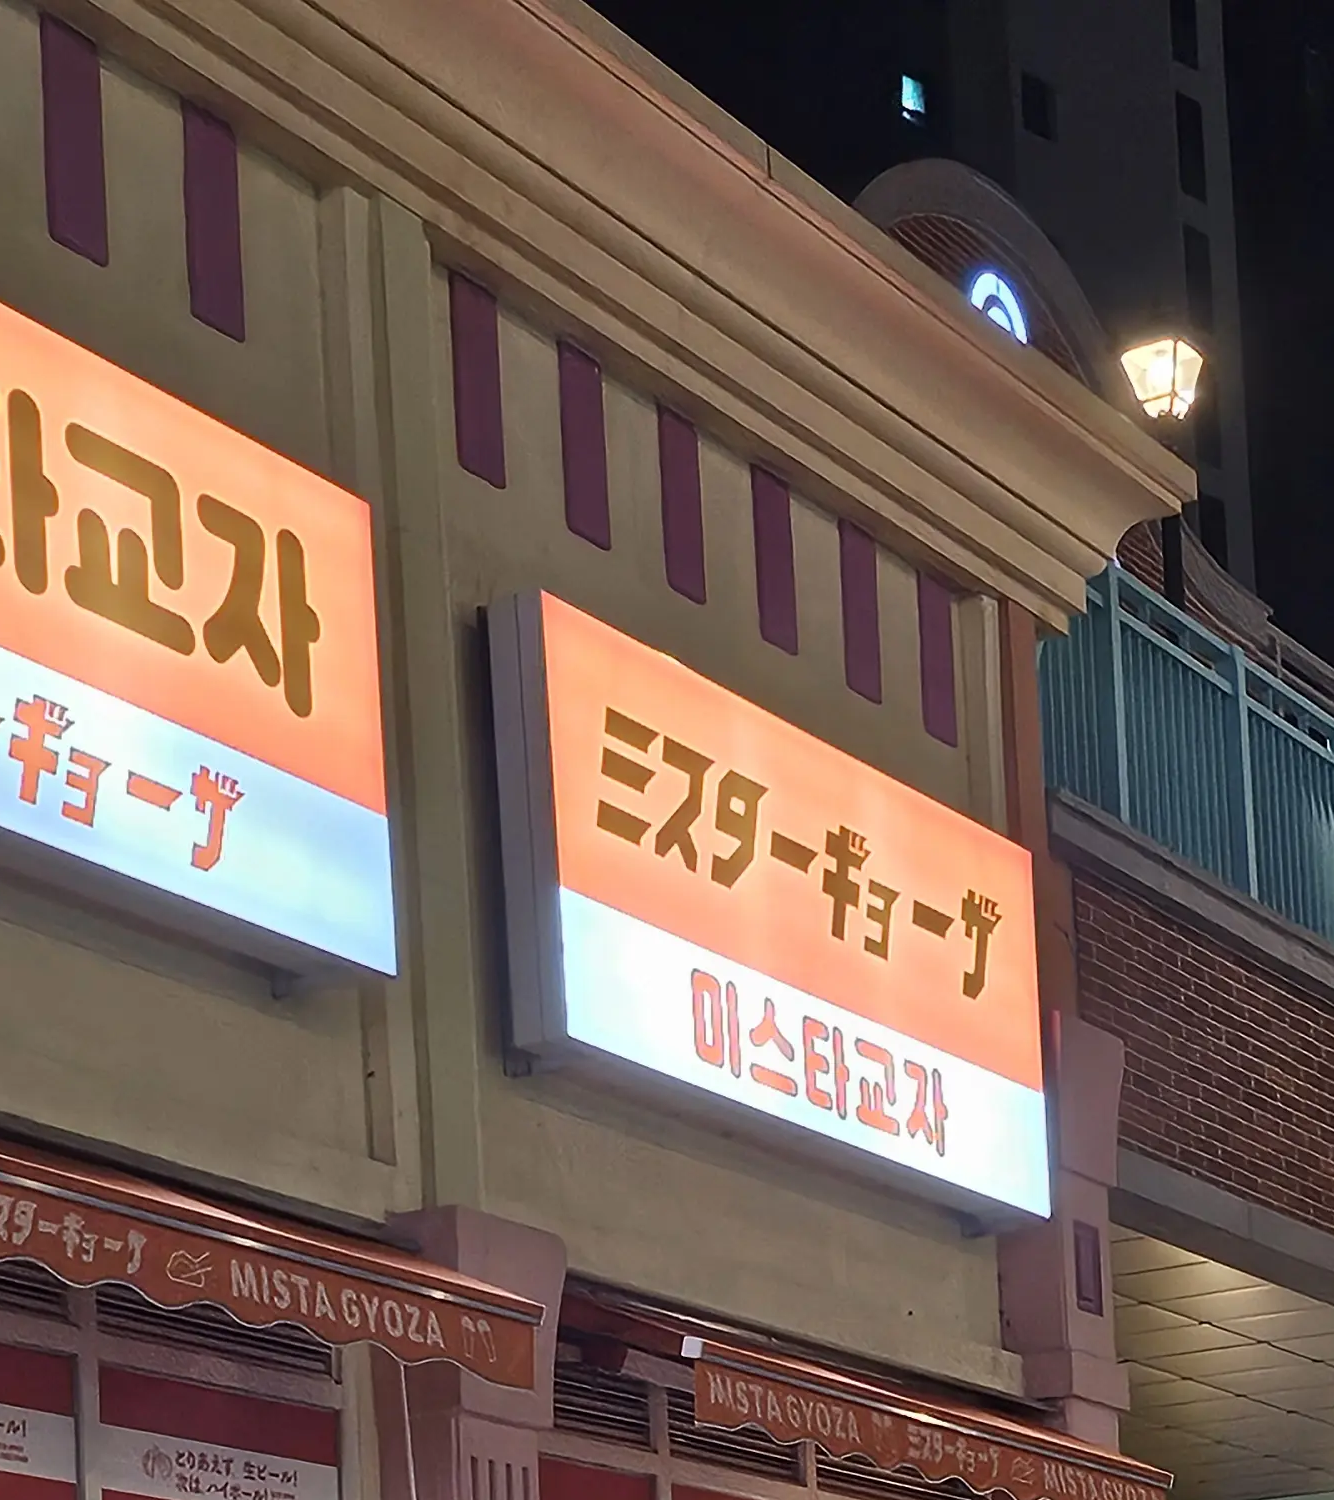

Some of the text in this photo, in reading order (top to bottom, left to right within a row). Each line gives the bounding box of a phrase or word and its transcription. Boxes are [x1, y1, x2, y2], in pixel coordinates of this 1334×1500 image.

[597, 706, 1002, 1000] ミスターギョーザ
[690, 968, 948, 1156] 미스타교자
[230, 1259, 447, 1350] MISTA GYOZA
[706, 1370, 862, 1445] MISTA GYOZA
[1043, 1461, 1098, 1500] MISTA
